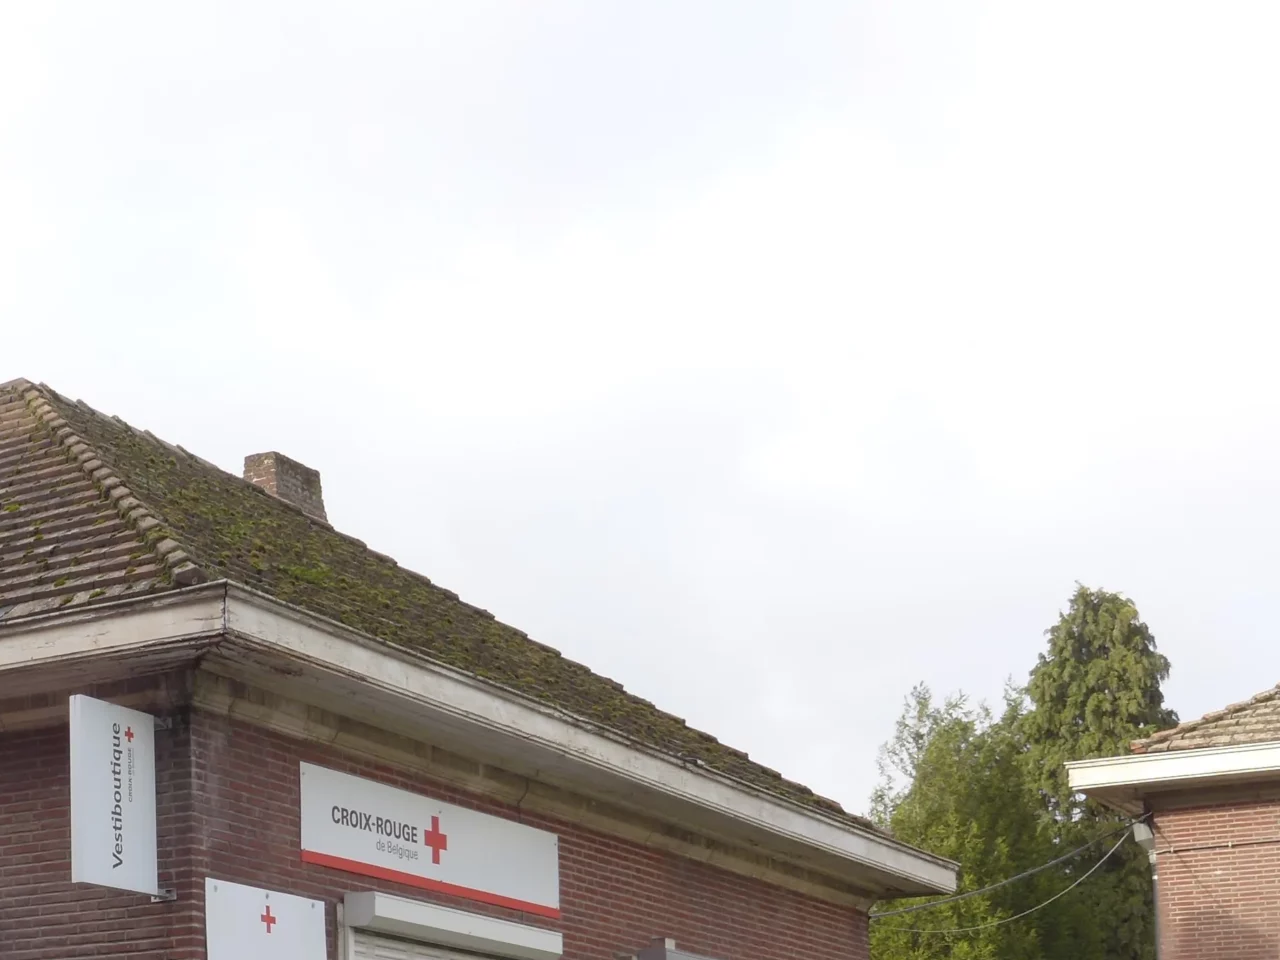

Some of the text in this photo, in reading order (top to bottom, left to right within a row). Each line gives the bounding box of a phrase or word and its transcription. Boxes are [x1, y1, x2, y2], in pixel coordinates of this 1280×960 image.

[110, 722, 123, 869] Vestiboutique
[331, 804, 418, 844] CROIX-ROUGE
[376, 839, 419, 861] de Belgique
